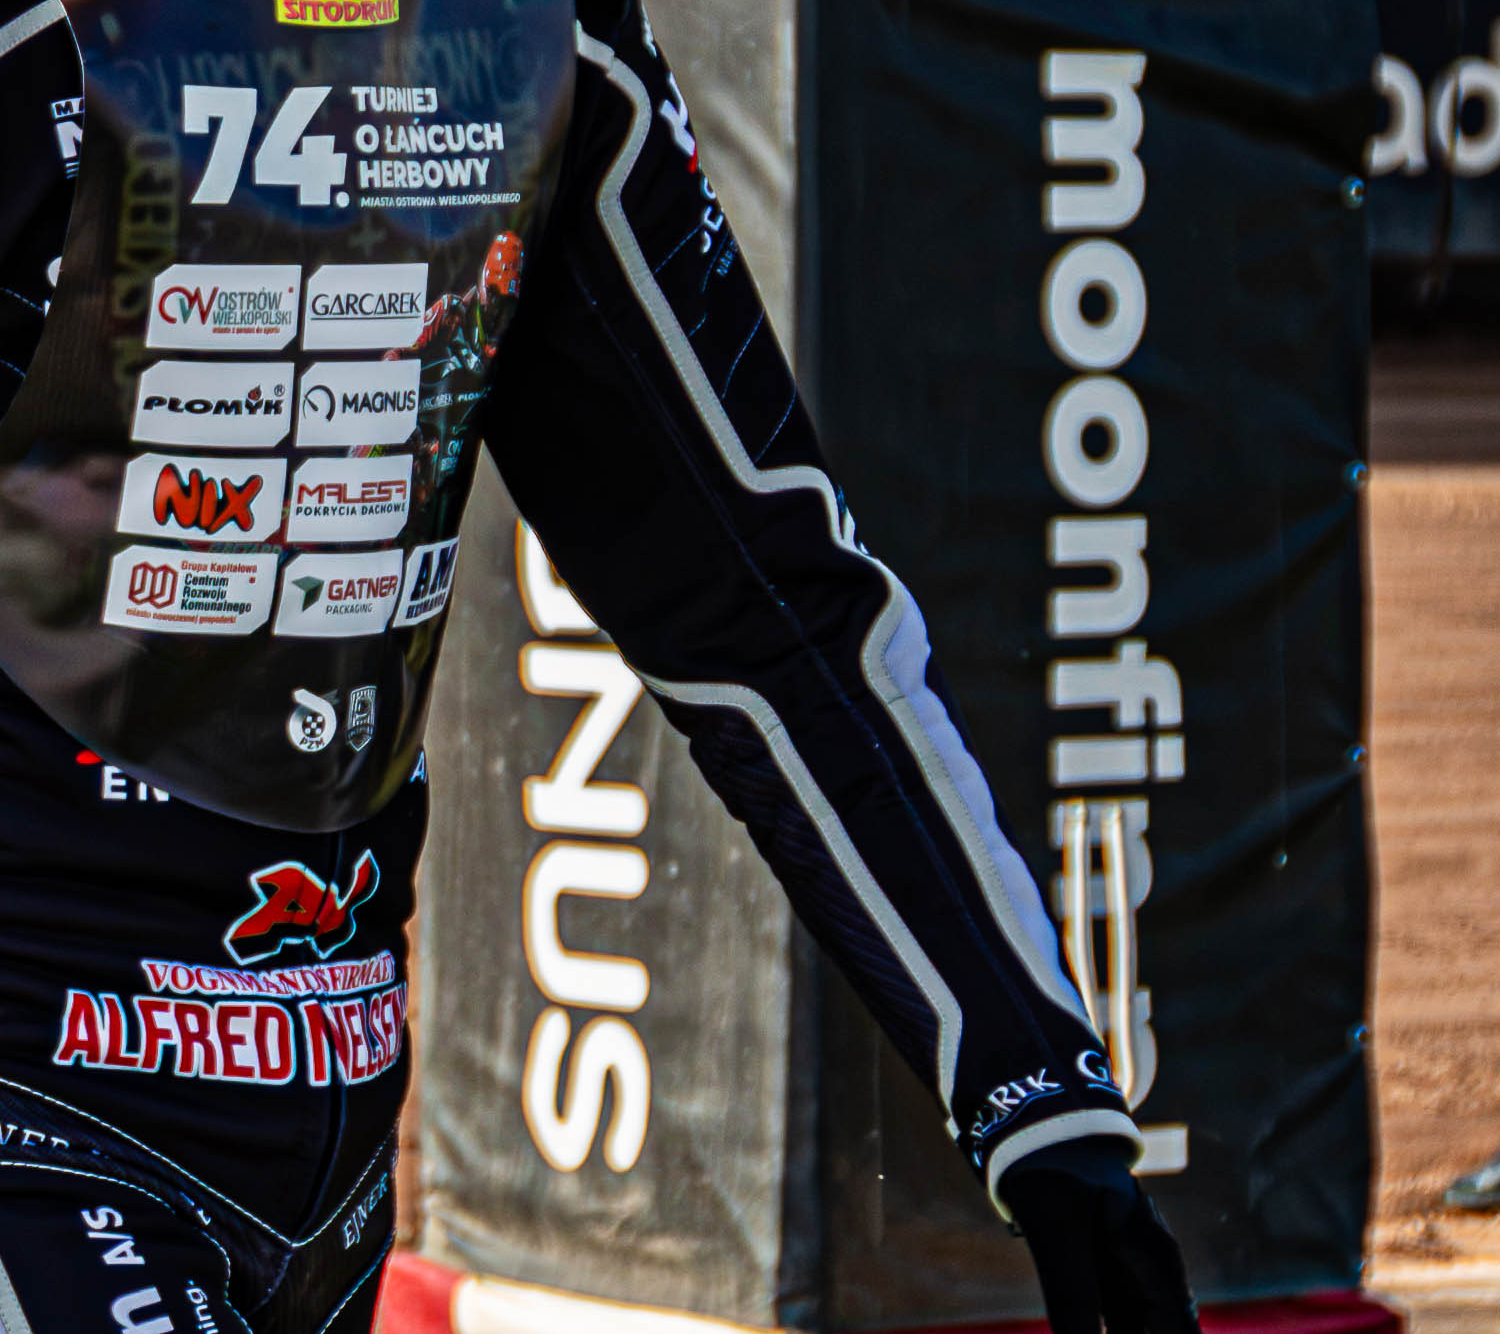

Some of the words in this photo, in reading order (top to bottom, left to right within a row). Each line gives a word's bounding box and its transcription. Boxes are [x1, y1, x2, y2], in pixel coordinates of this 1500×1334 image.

[181, 84, 350, 208] 74.
[350, 85, 439, 114] TURNIEJ
[355, 123, 380, 154] O
[384, 117, 505, 154] ŁAŃCUCH
[358, 158, 490, 189] HERBOWY
[360, 196, 395, 208] MIASTA
[395, 195, 438, 208] OSTROWA
[217, 286, 283, 312] OSTRÓW
[311, 291, 421, 317] GARCAREK
[212, 309, 293, 327] WIELKOPOLSKI
[342, 389, 417, 415] MAGNUS
[153, 462, 264, 535] NIX
[295, 504, 358, 517] POKRYCIA
[184, 573, 229, 587] Centrum
[327, 575, 399, 601] GATNER
[182, 586, 227, 601] Rozwoju
[180, 599, 252, 615] Komunalnego
[325, 603, 374, 616] PACKAGING
[53, 988, 297, 1086] ALFRED
[80, 1205, 146, 1267] A/S
